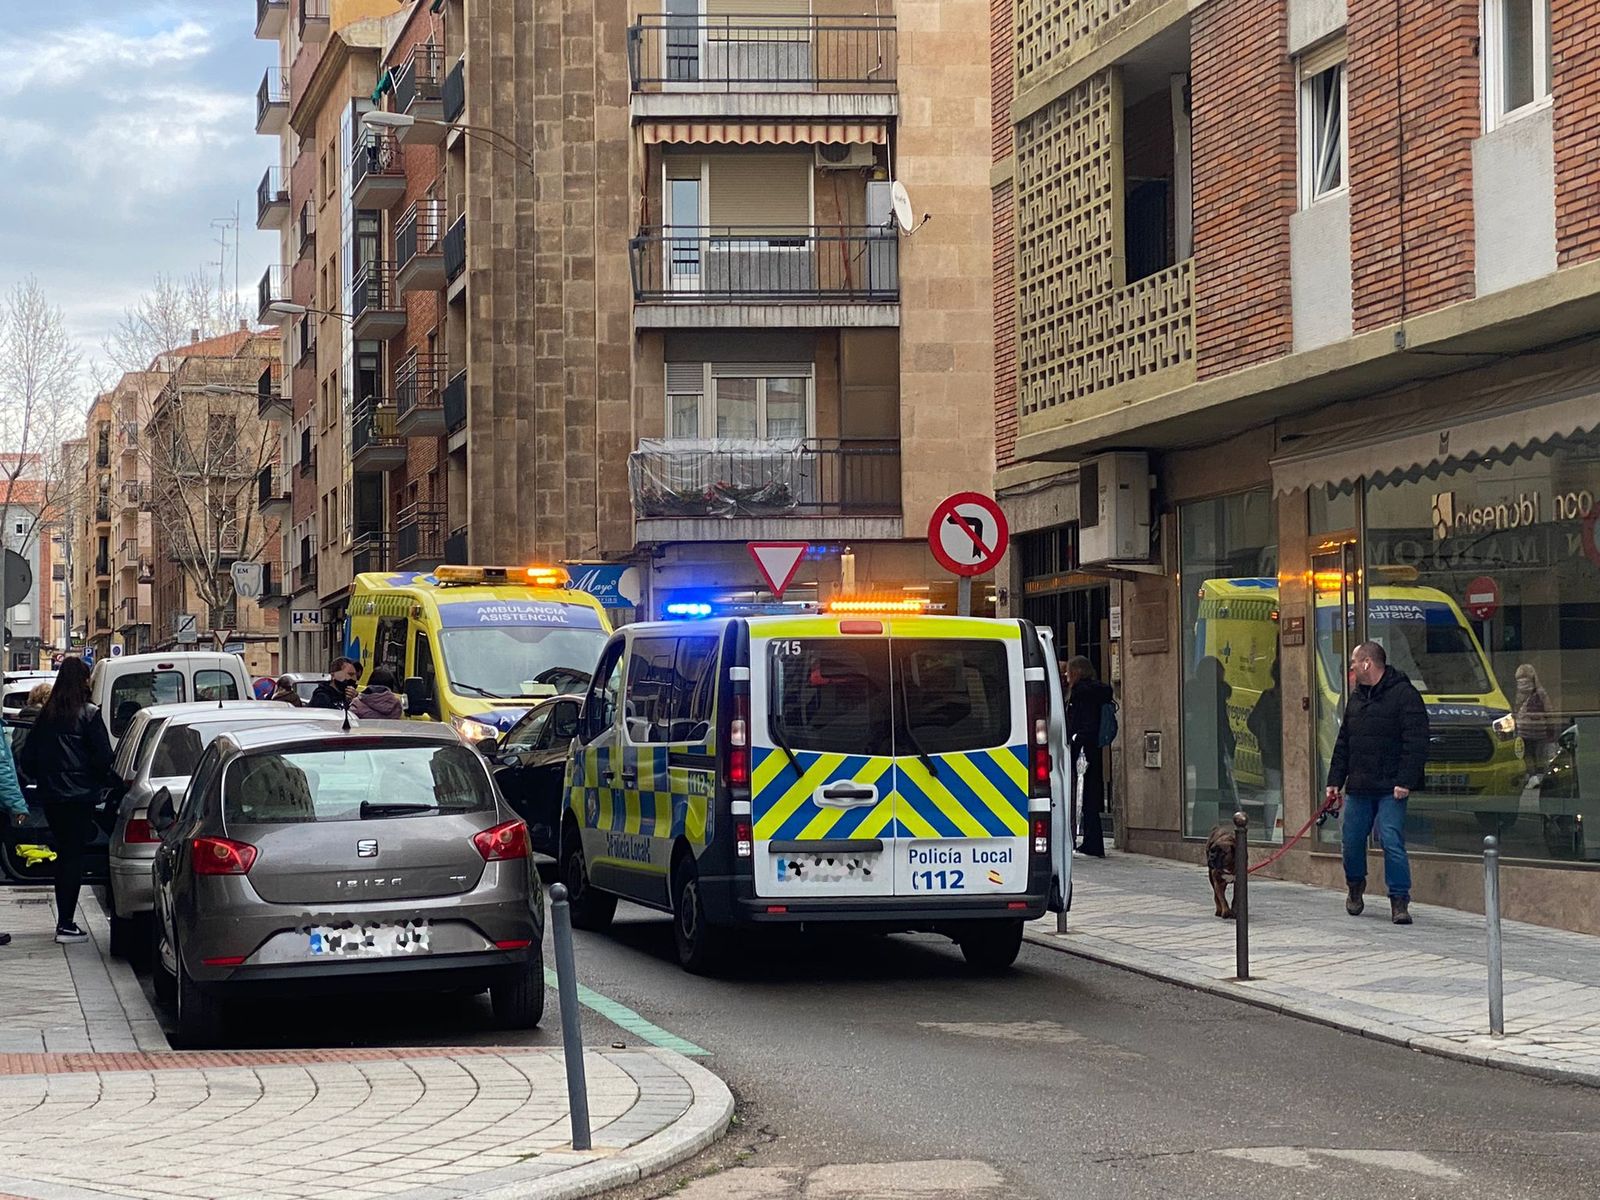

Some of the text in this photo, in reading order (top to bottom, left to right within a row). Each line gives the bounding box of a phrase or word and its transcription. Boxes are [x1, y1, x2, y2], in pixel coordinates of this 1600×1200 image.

[477, 606, 568, 616] AMBULANCIA
[480, 613, 569, 624] ASISTENCIAL
[86, 648, 93, 657] P
[771, 640, 802, 656] 715
[909, 847, 1012, 865] Policía Local
[920, 869, 965, 890] 112
